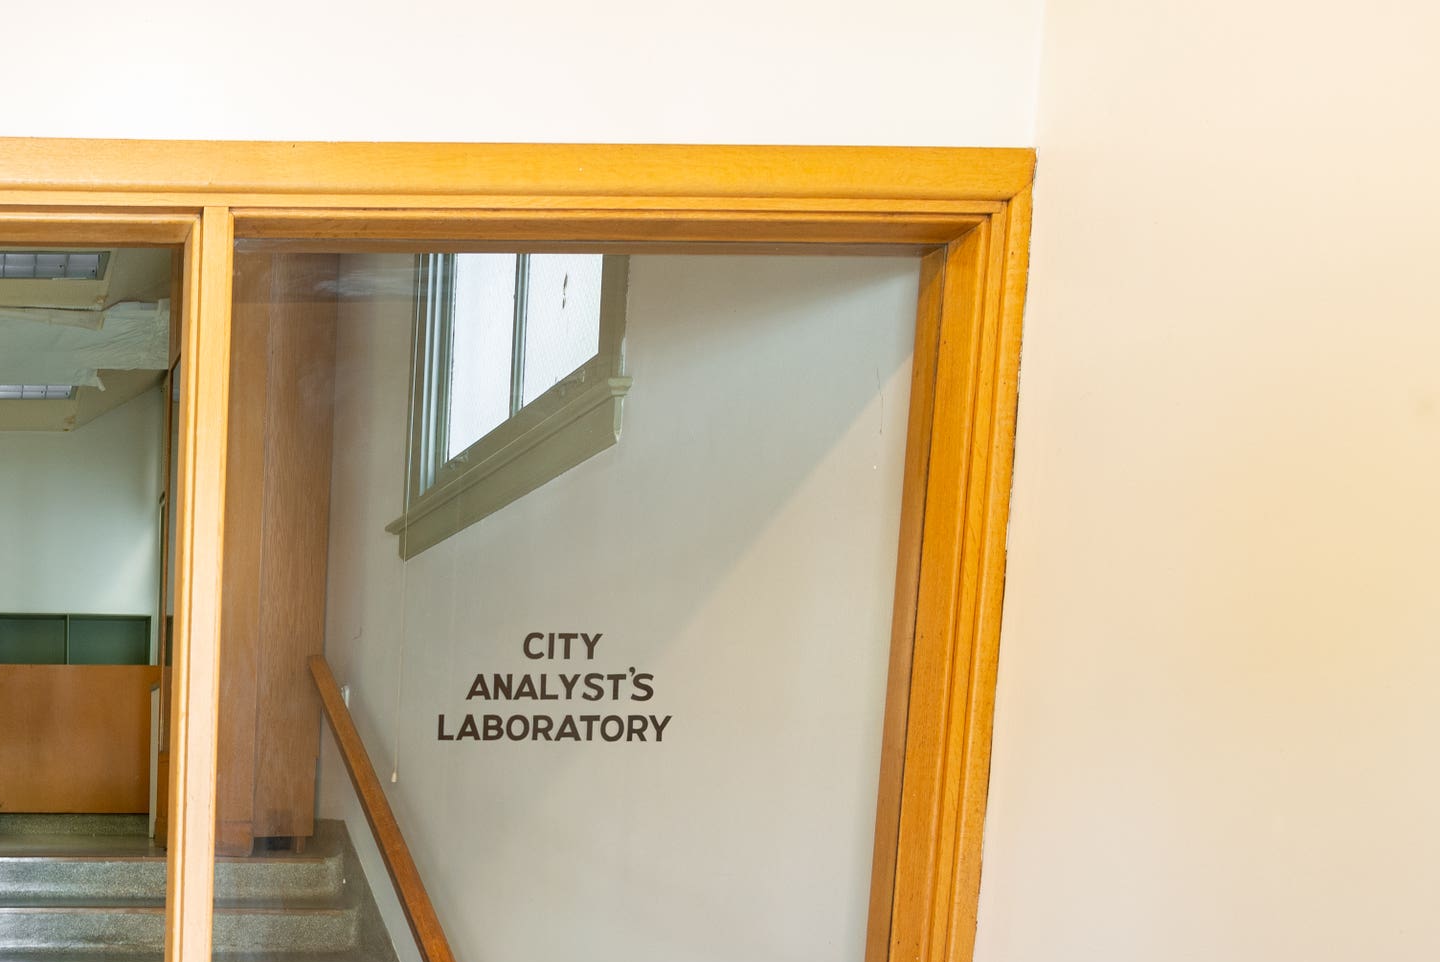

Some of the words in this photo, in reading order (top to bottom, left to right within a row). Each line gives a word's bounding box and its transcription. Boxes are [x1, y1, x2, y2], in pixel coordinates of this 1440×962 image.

[522, 631, 603, 660] CITY
[465, 666, 654, 702] ANALYST'S
[437, 713, 673, 743] LABORATORY
